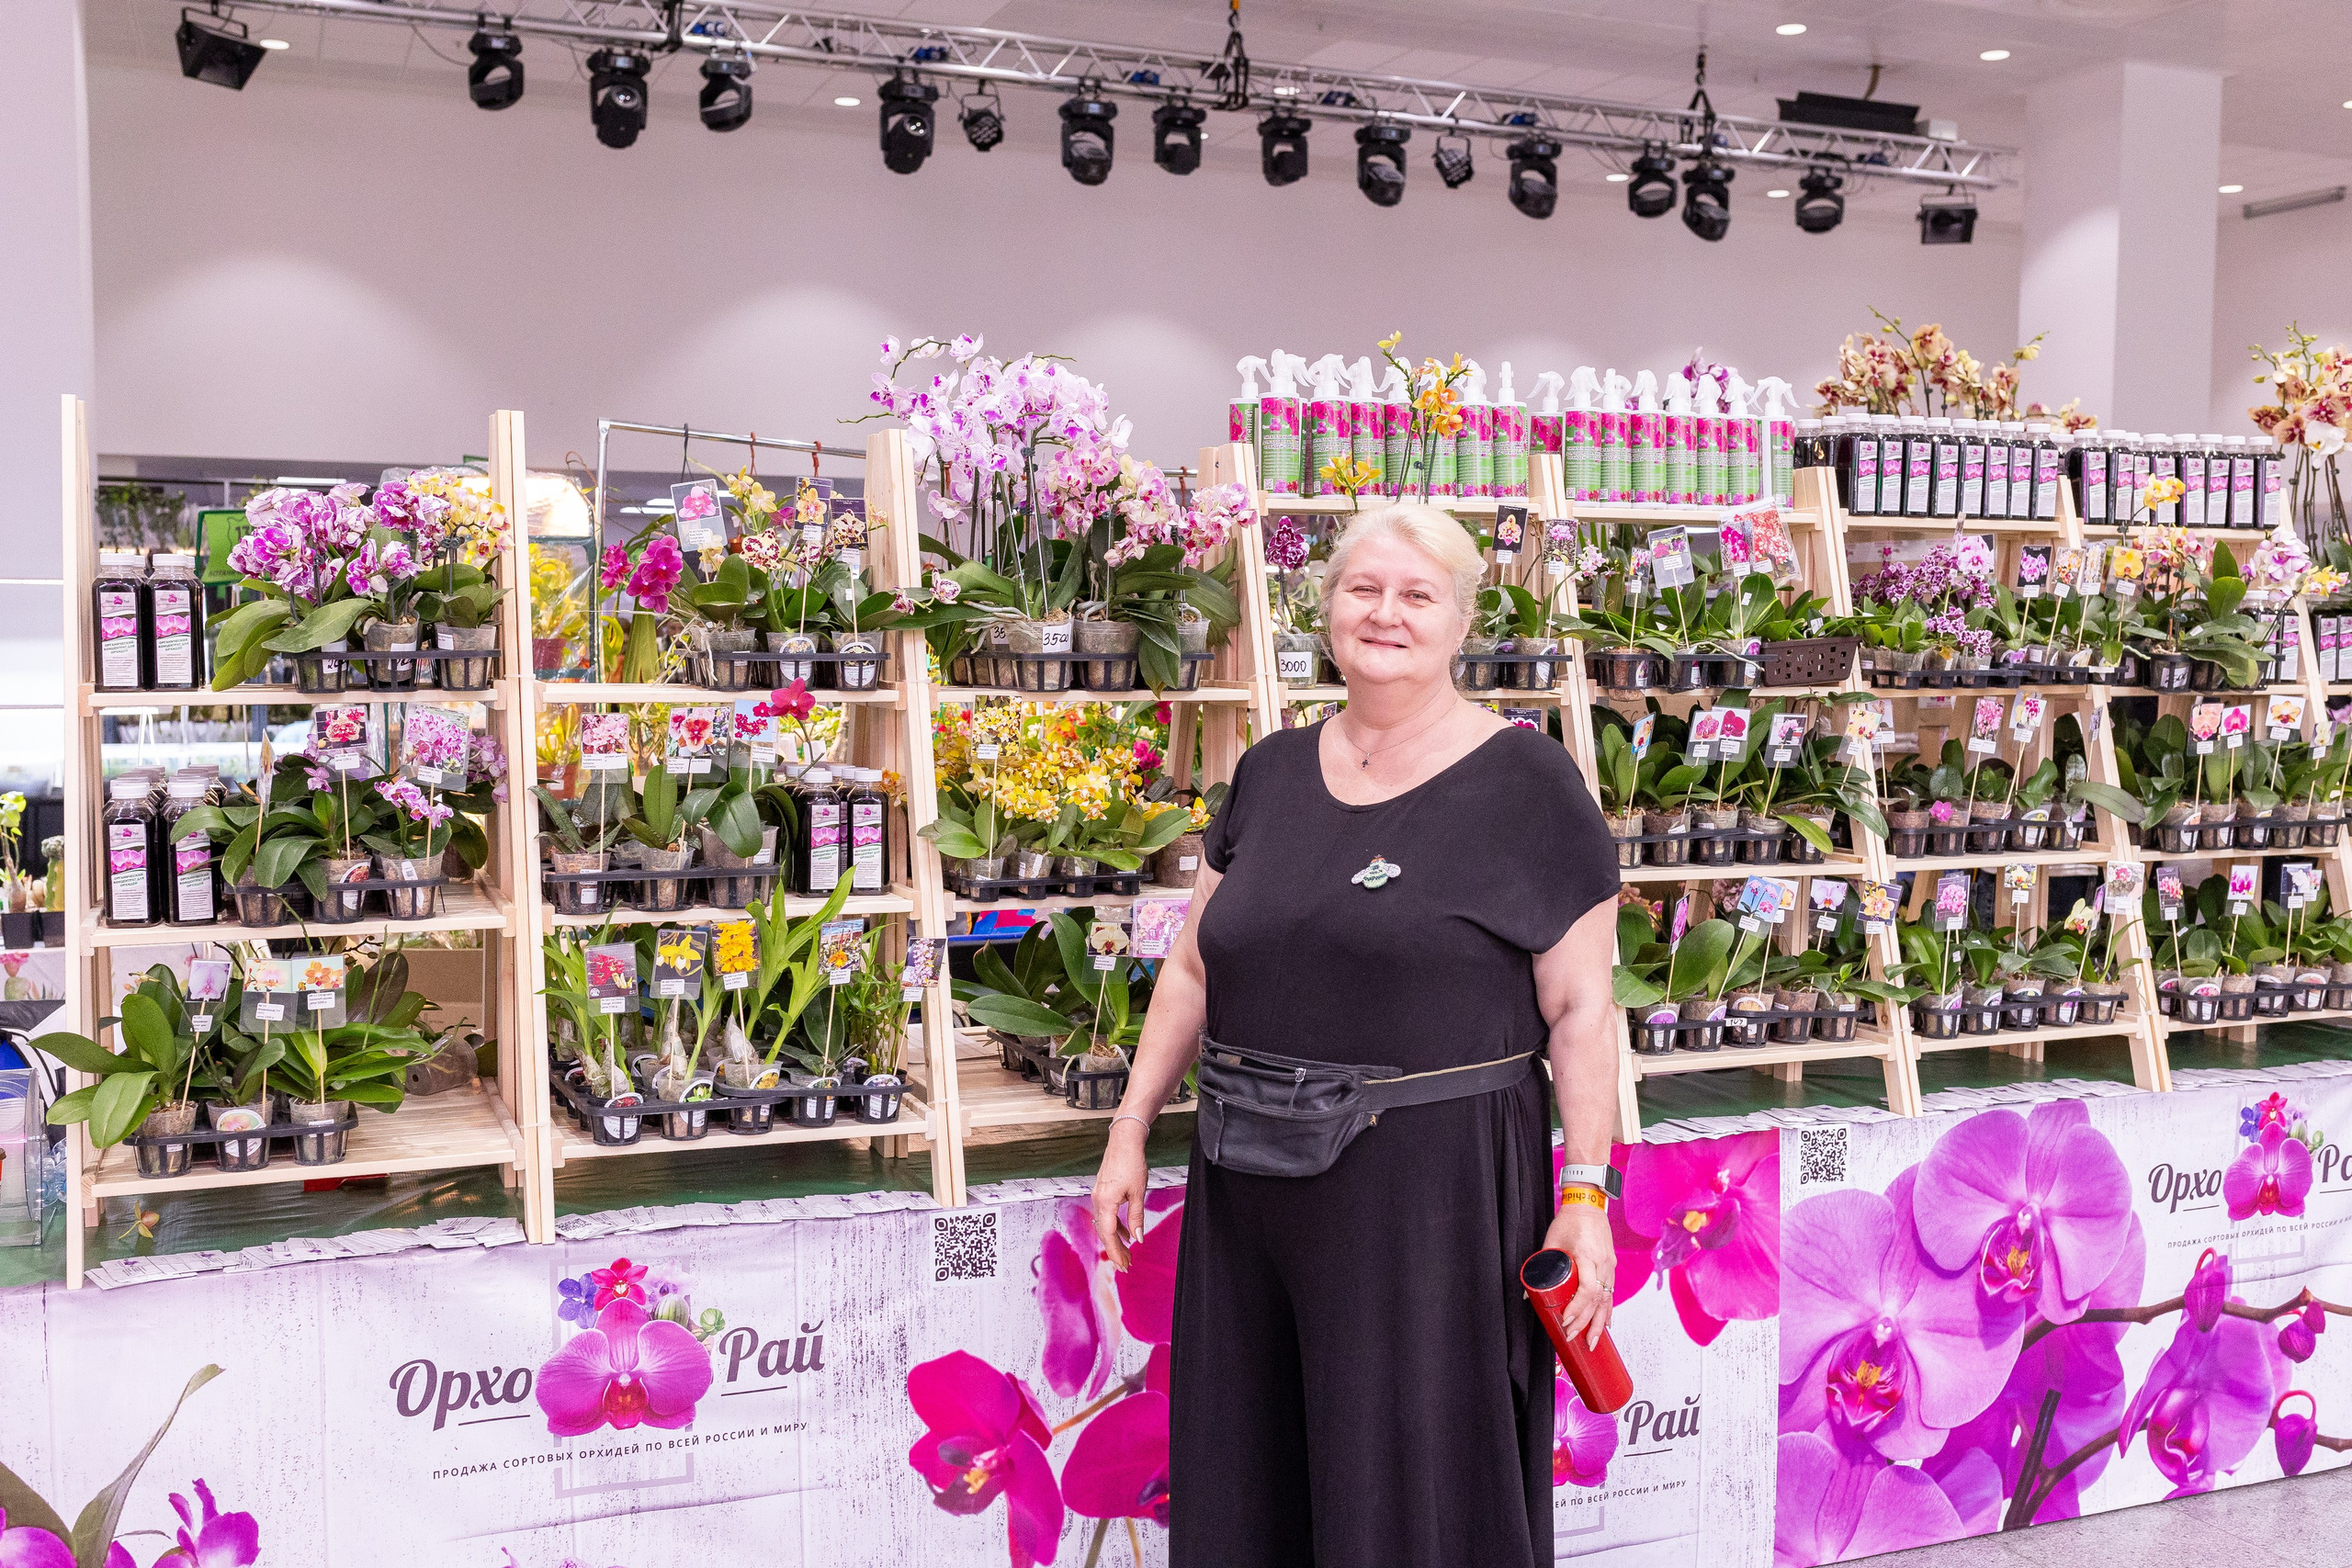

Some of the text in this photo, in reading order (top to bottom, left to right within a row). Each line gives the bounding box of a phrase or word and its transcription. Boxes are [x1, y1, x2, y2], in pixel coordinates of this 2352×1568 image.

[1281, 660, 1306, 672] 3000
[2148, 1163, 2222, 1214] Орхо
[2167, 1237, 2201, 1248] ПРОДАЖА
[2203, 1233, 2239, 1244] СОРТОВЫХ
[2242, 1225, 2274, 1237] ОРХИДЕЙ
[2290, 1222, 2309, 1232] ВСЕЙ
[2312, 1219, 2337, 1229] РОССИИ
[389, 1320, 825, 1431] Орхо Рай
[1623, 1393, 1702, 1446] Рай
[433, 1422, 808, 1479] ПРОДАЖА СОРТОВЫХ ОРХИДЕЙ ПО ВСЕЙ РОССИИ И МИРУ
[1571, 1497, 1584, 1506] ПО
[1588, 1492, 1610, 1503] ВСЕЙ
[1612, 1486, 1649, 1497] РОССИИ
[1663, 1480, 1687, 1491] МИРУ
